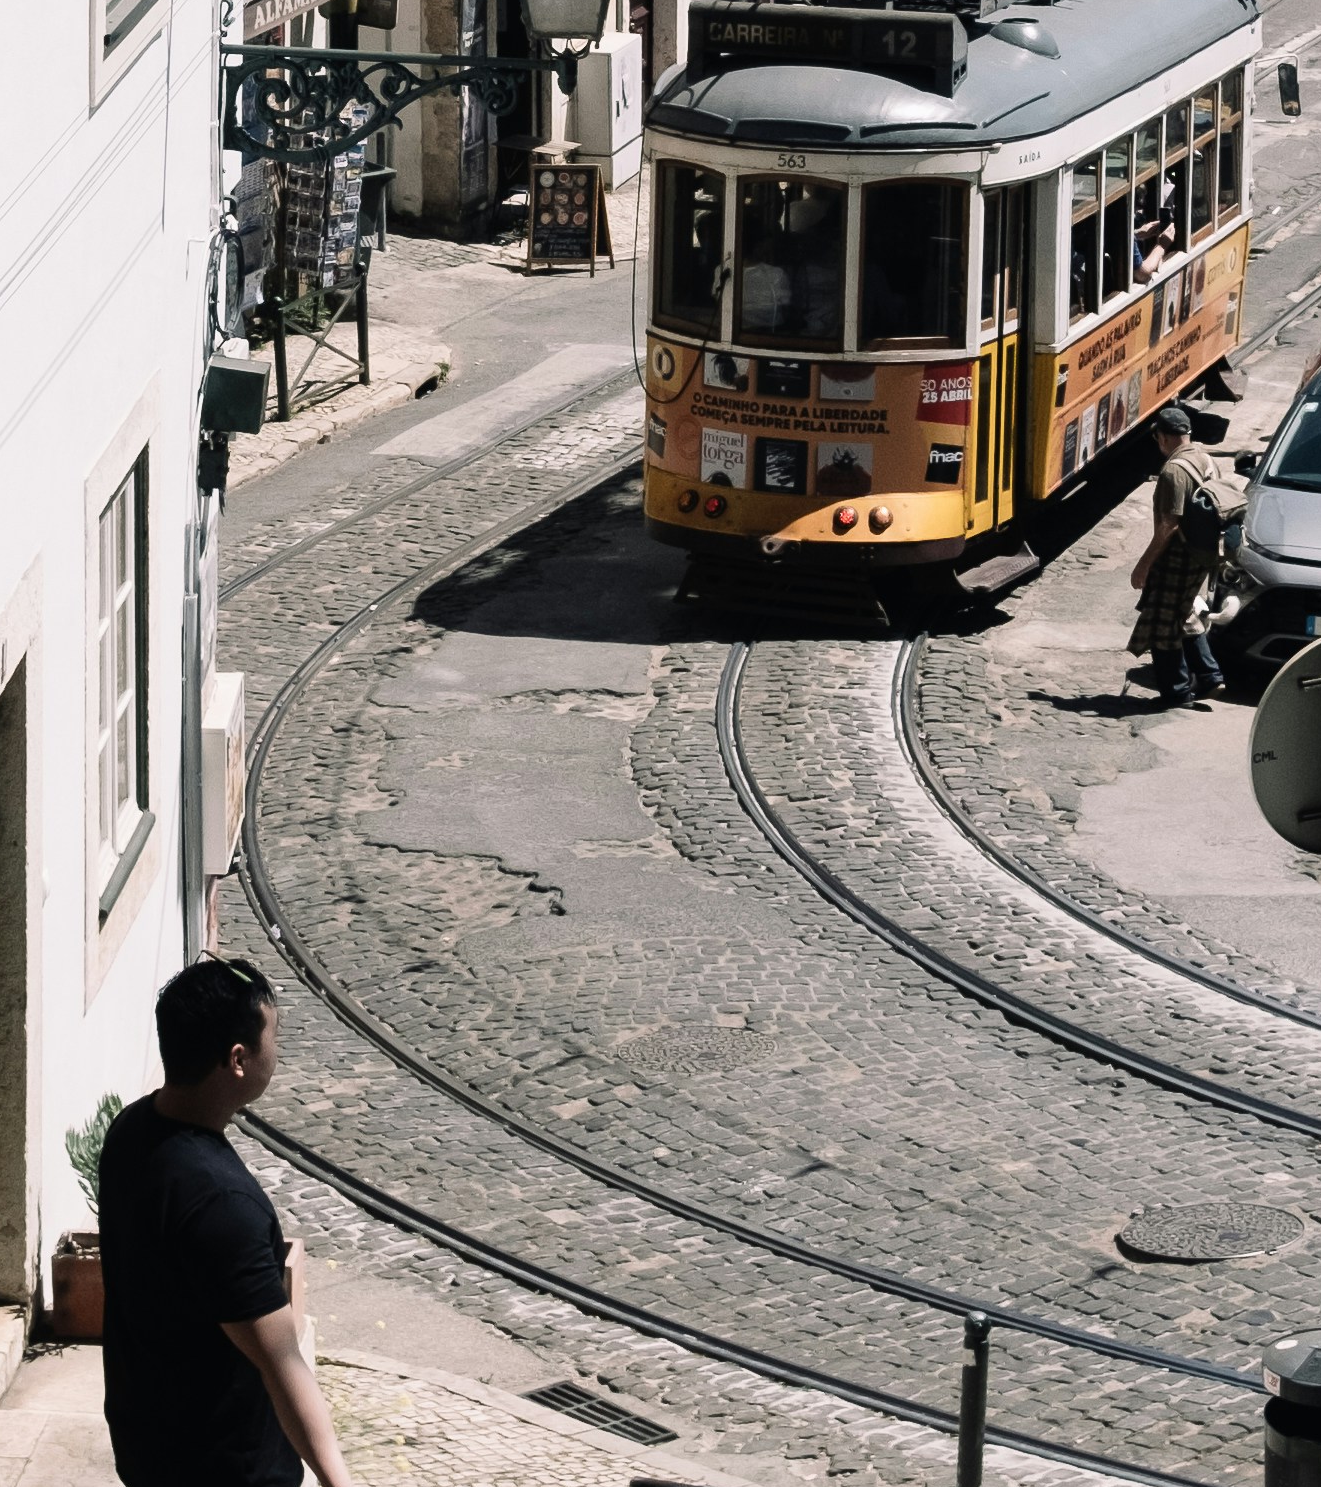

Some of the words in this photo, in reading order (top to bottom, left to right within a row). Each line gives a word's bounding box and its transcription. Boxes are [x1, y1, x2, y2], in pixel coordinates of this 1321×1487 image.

[709, 22, 810, 46] CARREIRA
[883, 30, 917, 57] 12
[777, 154, 806, 169] 563
[939, 376, 972, 391] ANOS
[922, 391, 938, 404] 25
[940, 388, 973, 402] ABRIL
[693, 392, 702, 403] O
[704, 394, 759, 413] CAMINHO
[762, 402, 797, 417] PARA
[799, 406, 810, 419] A
[812, 407, 888, 422] LIBERDADE
[690, 404, 738, 425] COMEÇA
[741, 414, 791, 429] SEMPRE
[793, 417, 827, 432] PELA
[704, 431, 744, 449] miguel
[703, 443, 744, 469] torga
[929, 450, 963, 464] fnac
[1253, 750, 1277, 764] CML
